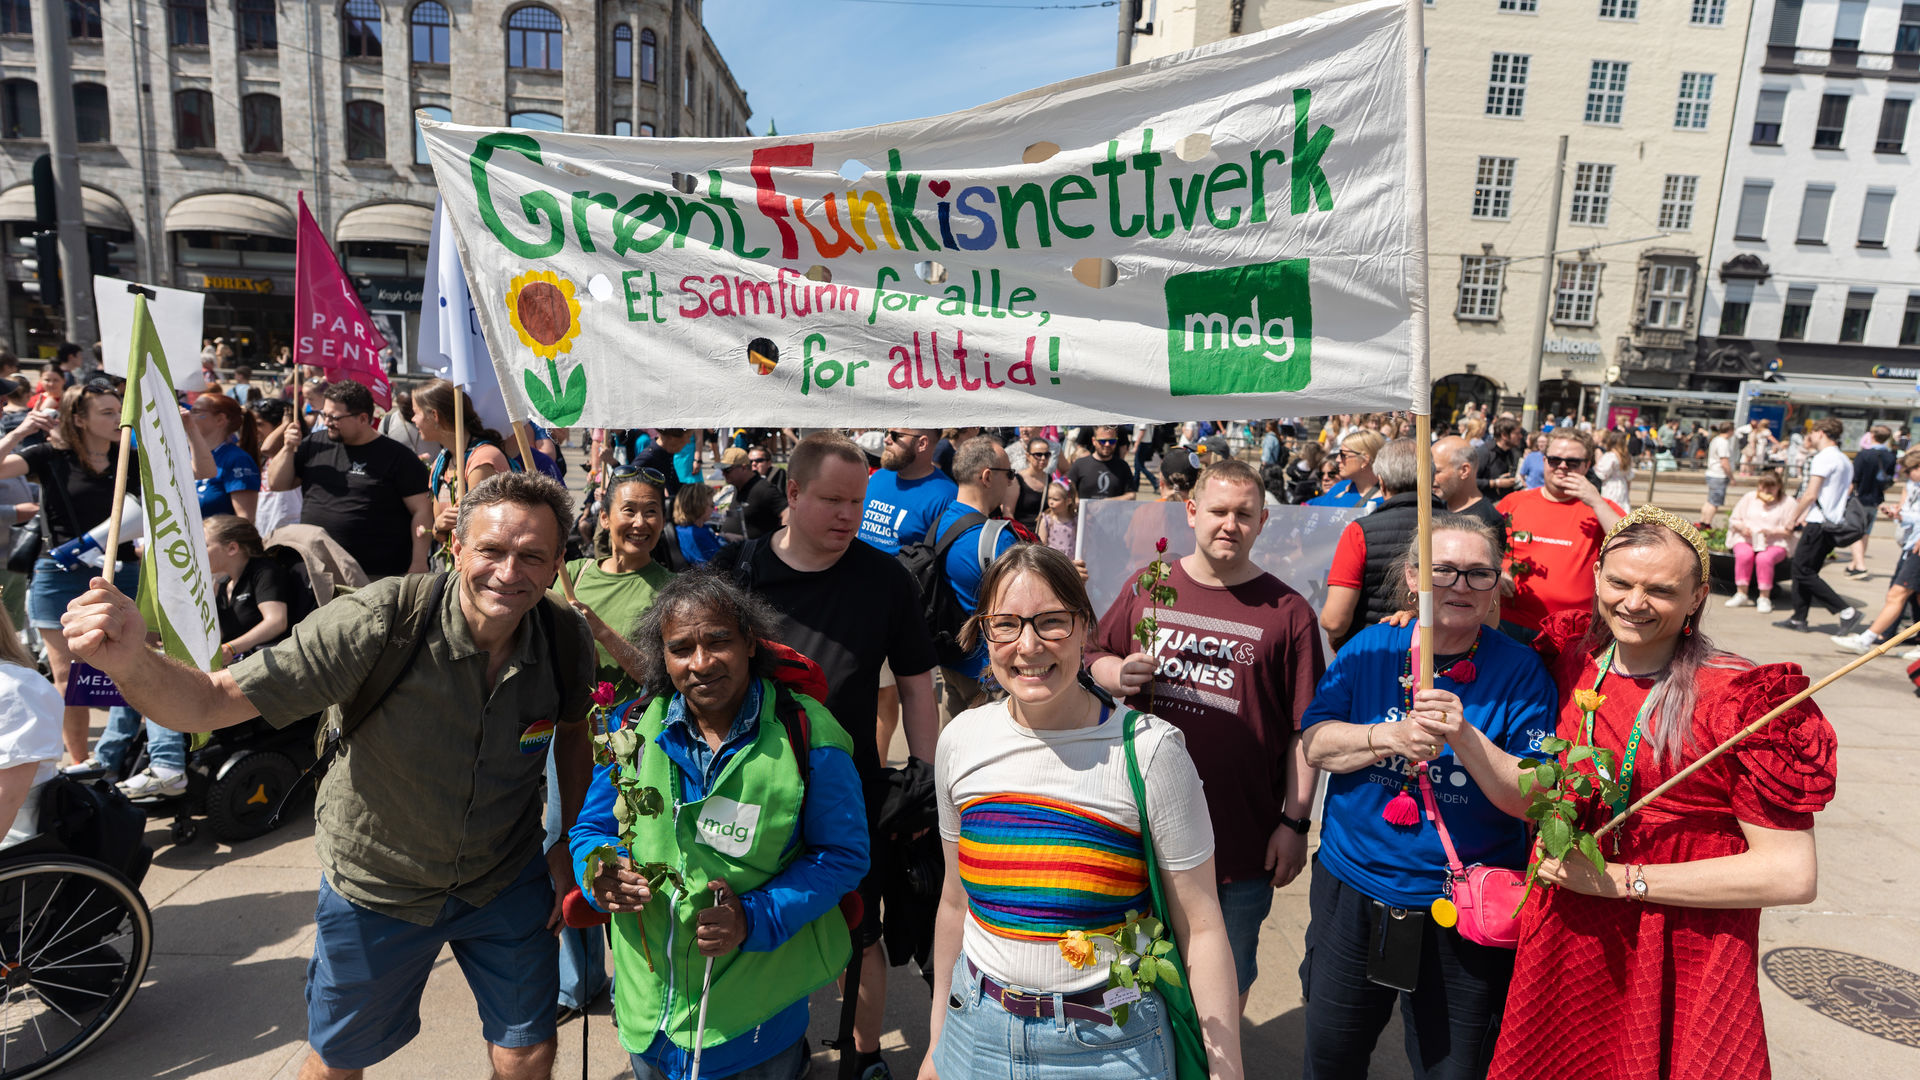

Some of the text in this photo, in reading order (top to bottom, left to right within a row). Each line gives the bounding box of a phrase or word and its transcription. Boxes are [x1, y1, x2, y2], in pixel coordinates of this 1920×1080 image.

[470, 110, 1334, 259] Grønt Funkisnettverk
[203, 275, 254, 290] FOREX
[623, 267, 1051, 327] Et samfunn for alle,
[1185, 296, 1294, 362] mdg
[801, 330, 1060, 396] for alltid!
[864, 509, 892, 525] STERK
[868, 499, 896, 514] STOLT
[861, 520, 892, 538] SYNLIG
[1167, 630, 1254, 666] JACK &
[1154, 655, 1235, 690] JONES
[525, 731, 552, 745] mdg
[702, 817, 749, 843] mdg
